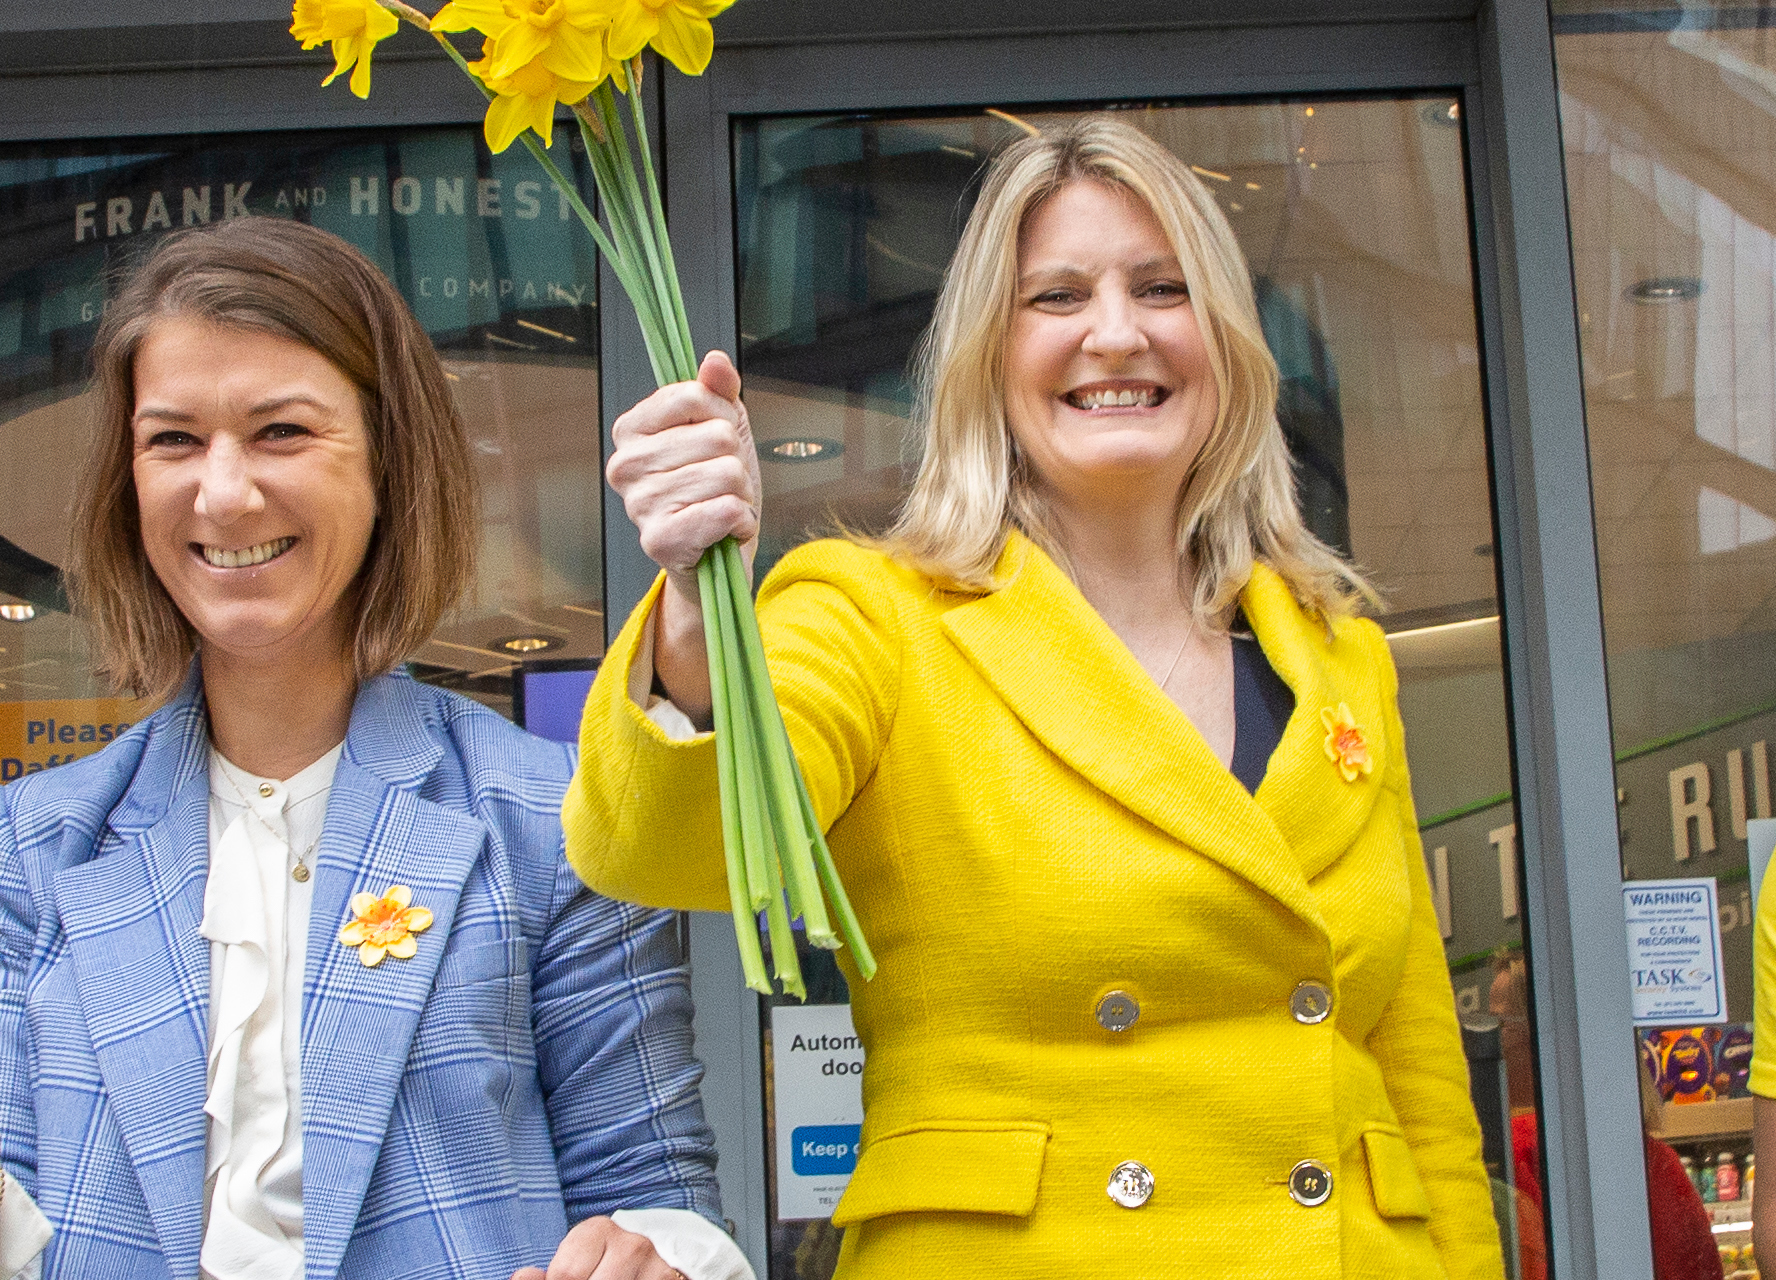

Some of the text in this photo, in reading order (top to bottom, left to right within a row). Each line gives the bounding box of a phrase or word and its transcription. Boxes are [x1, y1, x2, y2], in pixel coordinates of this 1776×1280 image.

[74, 176, 577, 241] FRANK AND HONEST
[419, 276, 586, 306] COMPANY
[1630, 891, 1702, 906] WARNING
[1637, 935, 1701, 947] RECORDING
[1631, 968, 1686, 987] TASK
[790, 1034, 864, 1052] Autom
[821, 1060, 864, 1076] doo
[802, 1140, 848, 1160] Keep
